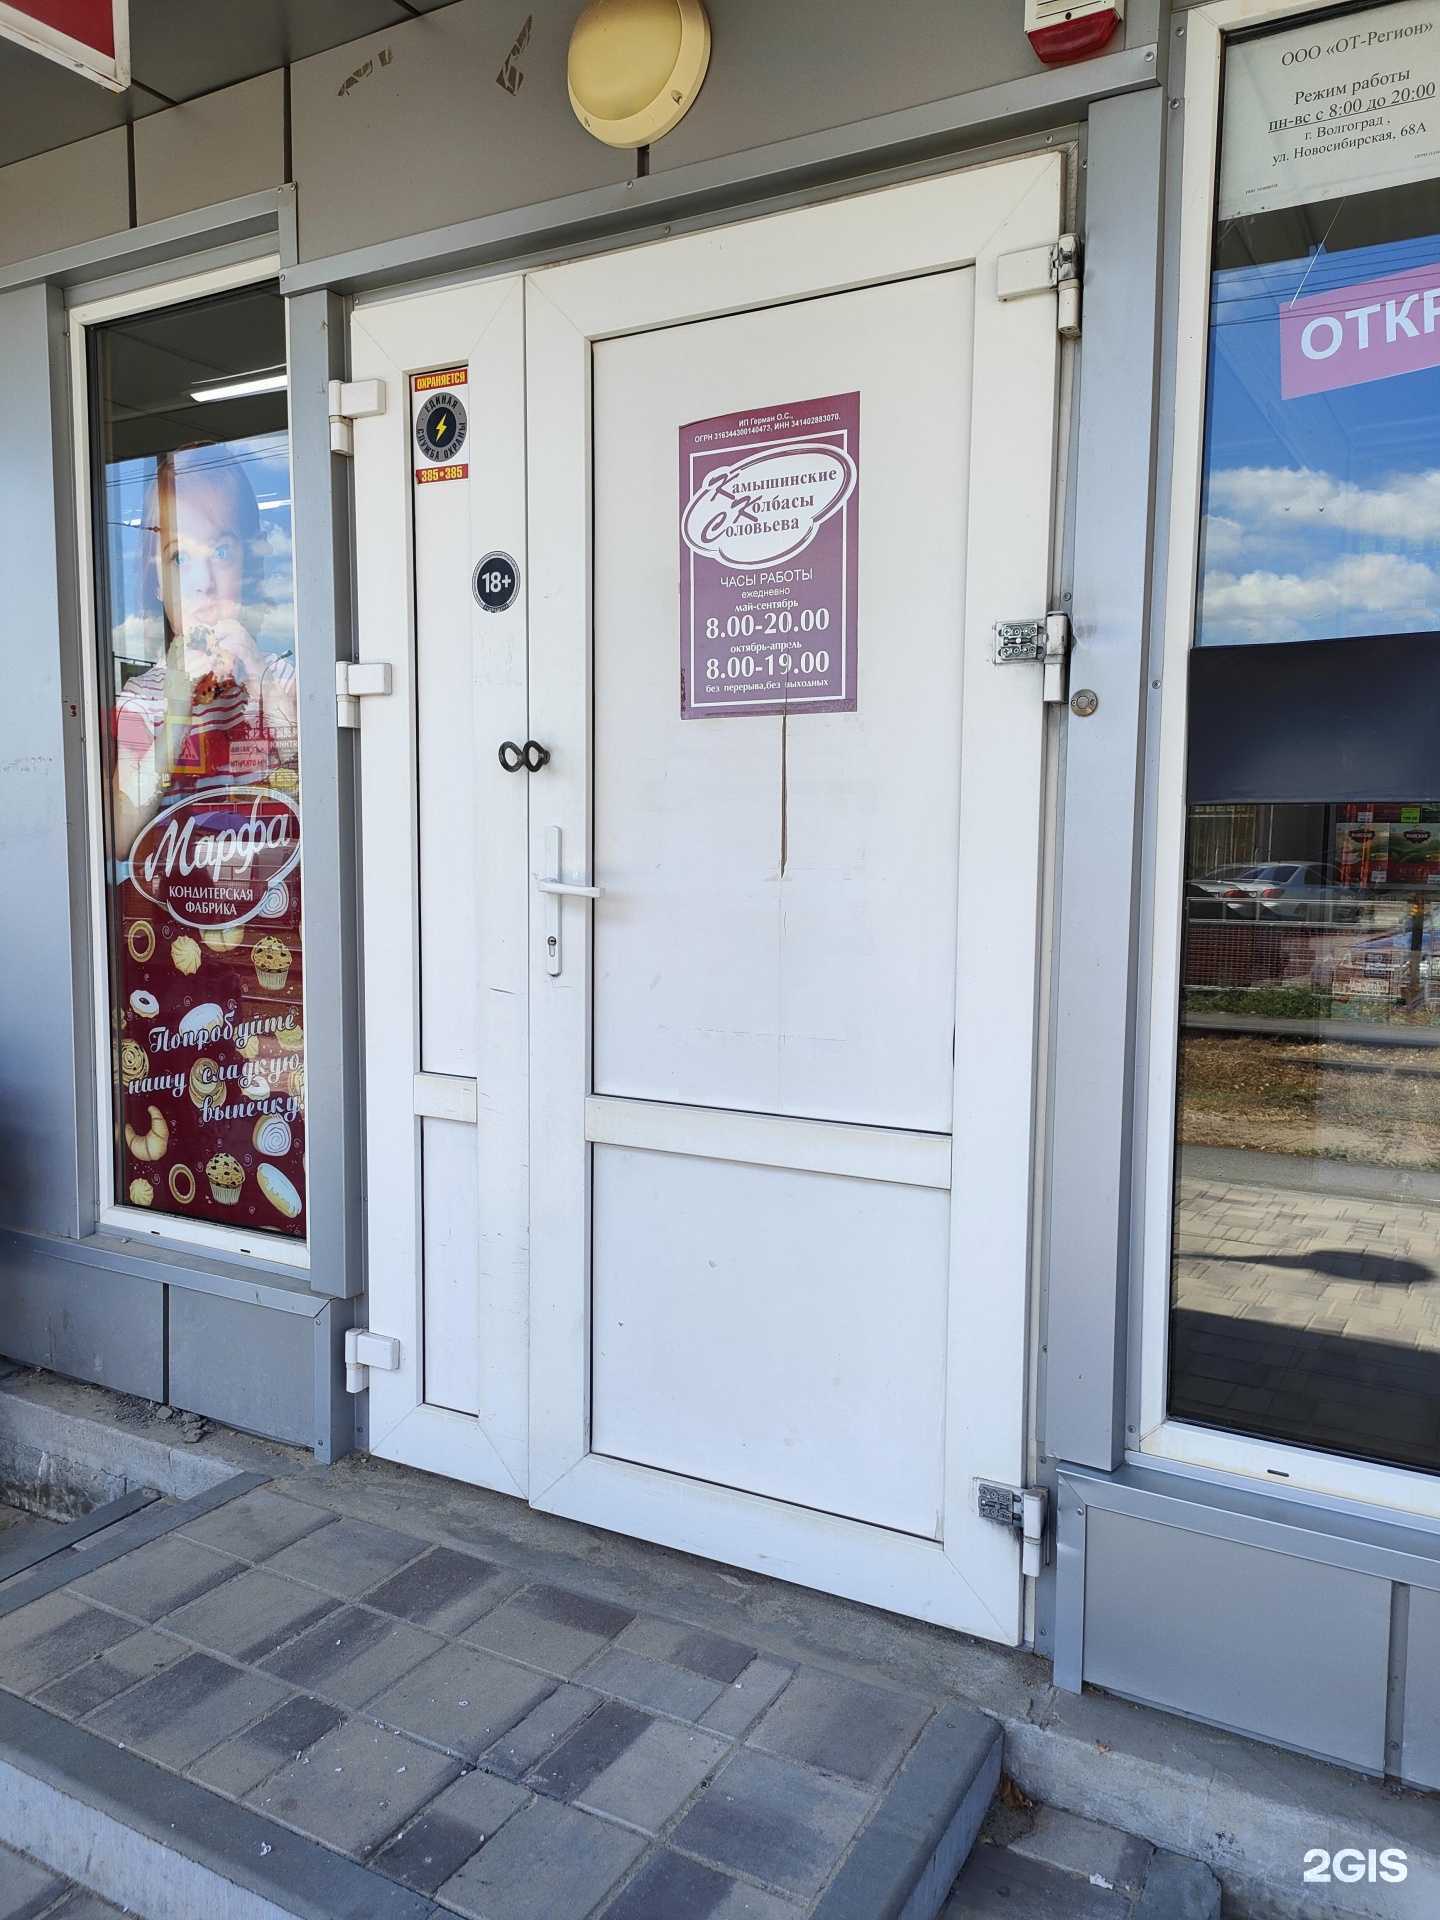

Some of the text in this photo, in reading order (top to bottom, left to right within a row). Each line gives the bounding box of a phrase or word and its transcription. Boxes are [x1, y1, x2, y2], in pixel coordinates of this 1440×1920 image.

[1281, 22, 1433, 66] ООО «ОТ-Регион»
[1295, 70, 1410, 105] Режим работы
[1269, 82, 1436, 131] пн-вс с 8:00 до 20:00
[1272, 153, 1289, 167] ул.
[1401, 122, 1426, 137] 68А
[417, 371, 465, 390] ОХРАНЯЕТСЯ
[424, 396, 458, 413] ЕДИНАЯ
[694, 433, 713, 443] ОГРН
[774, 422, 790, 431] ИНН
[739, 419, 749, 427] ИП
[750, 415, 775, 427] Герман
[417, 423, 465, 460] СЛУЖБА ОХРАНЫ
[708, 469, 837, 502] Камышинские
[731, 495, 814, 524] Колбасы
[701, 511, 799, 543] Соловьева
[482, 571, 512, 593] 18+
[721, 568, 813, 588] ЧАСЫ РАБОТЫ
[735, 599, 799, 613] май-сентябрь
[741, 587, 791, 599] ежедневно
[706, 608, 830, 639] 8.00-20.00
[730, 641, 802, 654] октябрь-апрель
[706, 651, 830, 679] 8.00-19.00
[706, 684, 720, 693] без
[784, 679, 829, 689] выходных
[144, 795, 289, 882] Марфа
[169, 885, 253, 901] КОНДИТЕРСКАЯ
[185, 902, 237, 915] ФАБРИКА
[149, 1010, 297, 1053] Попробуйте
[128, 1054, 300, 1098] нашу сладкую
